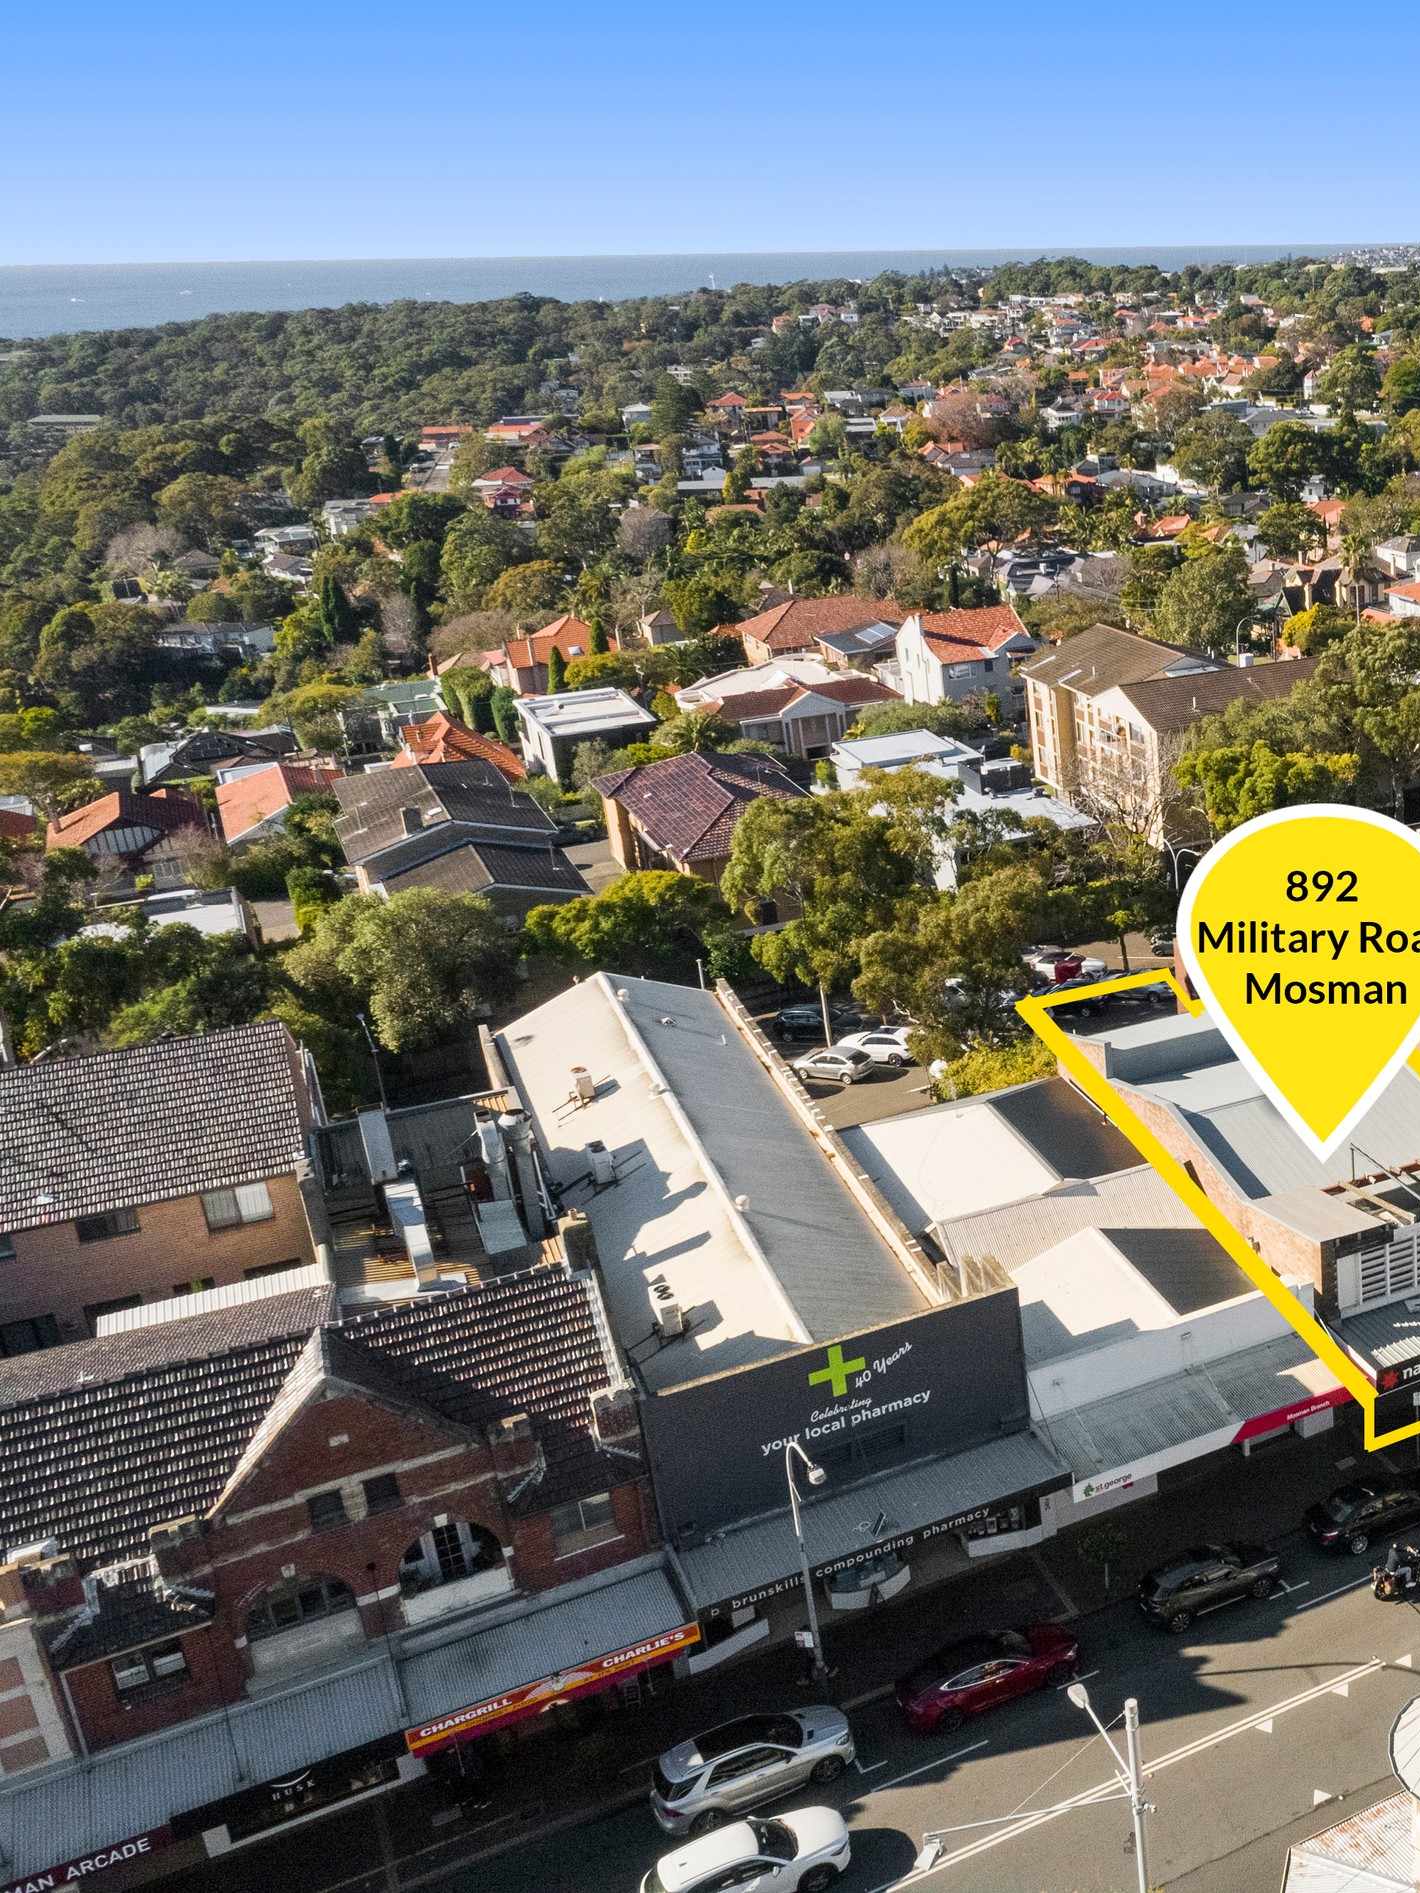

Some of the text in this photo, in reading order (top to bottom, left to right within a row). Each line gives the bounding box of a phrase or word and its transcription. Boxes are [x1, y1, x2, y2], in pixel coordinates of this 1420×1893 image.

[855, 1341, 912, 1388] 40 Years
[761, 1390, 931, 1456] your local pharmacy
[1286, 1400, 1329, 1421] Mosman Branch
[815, 1535, 914, 1578] compounding
[922, 1507, 990, 1540] pharmacy
[419, 1631, 685, 1737] CHARGRILL CHARLIE'S
[272, 1780, 315, 1800] HUSK
[66, 1837, 151, 1880] ARCADE
